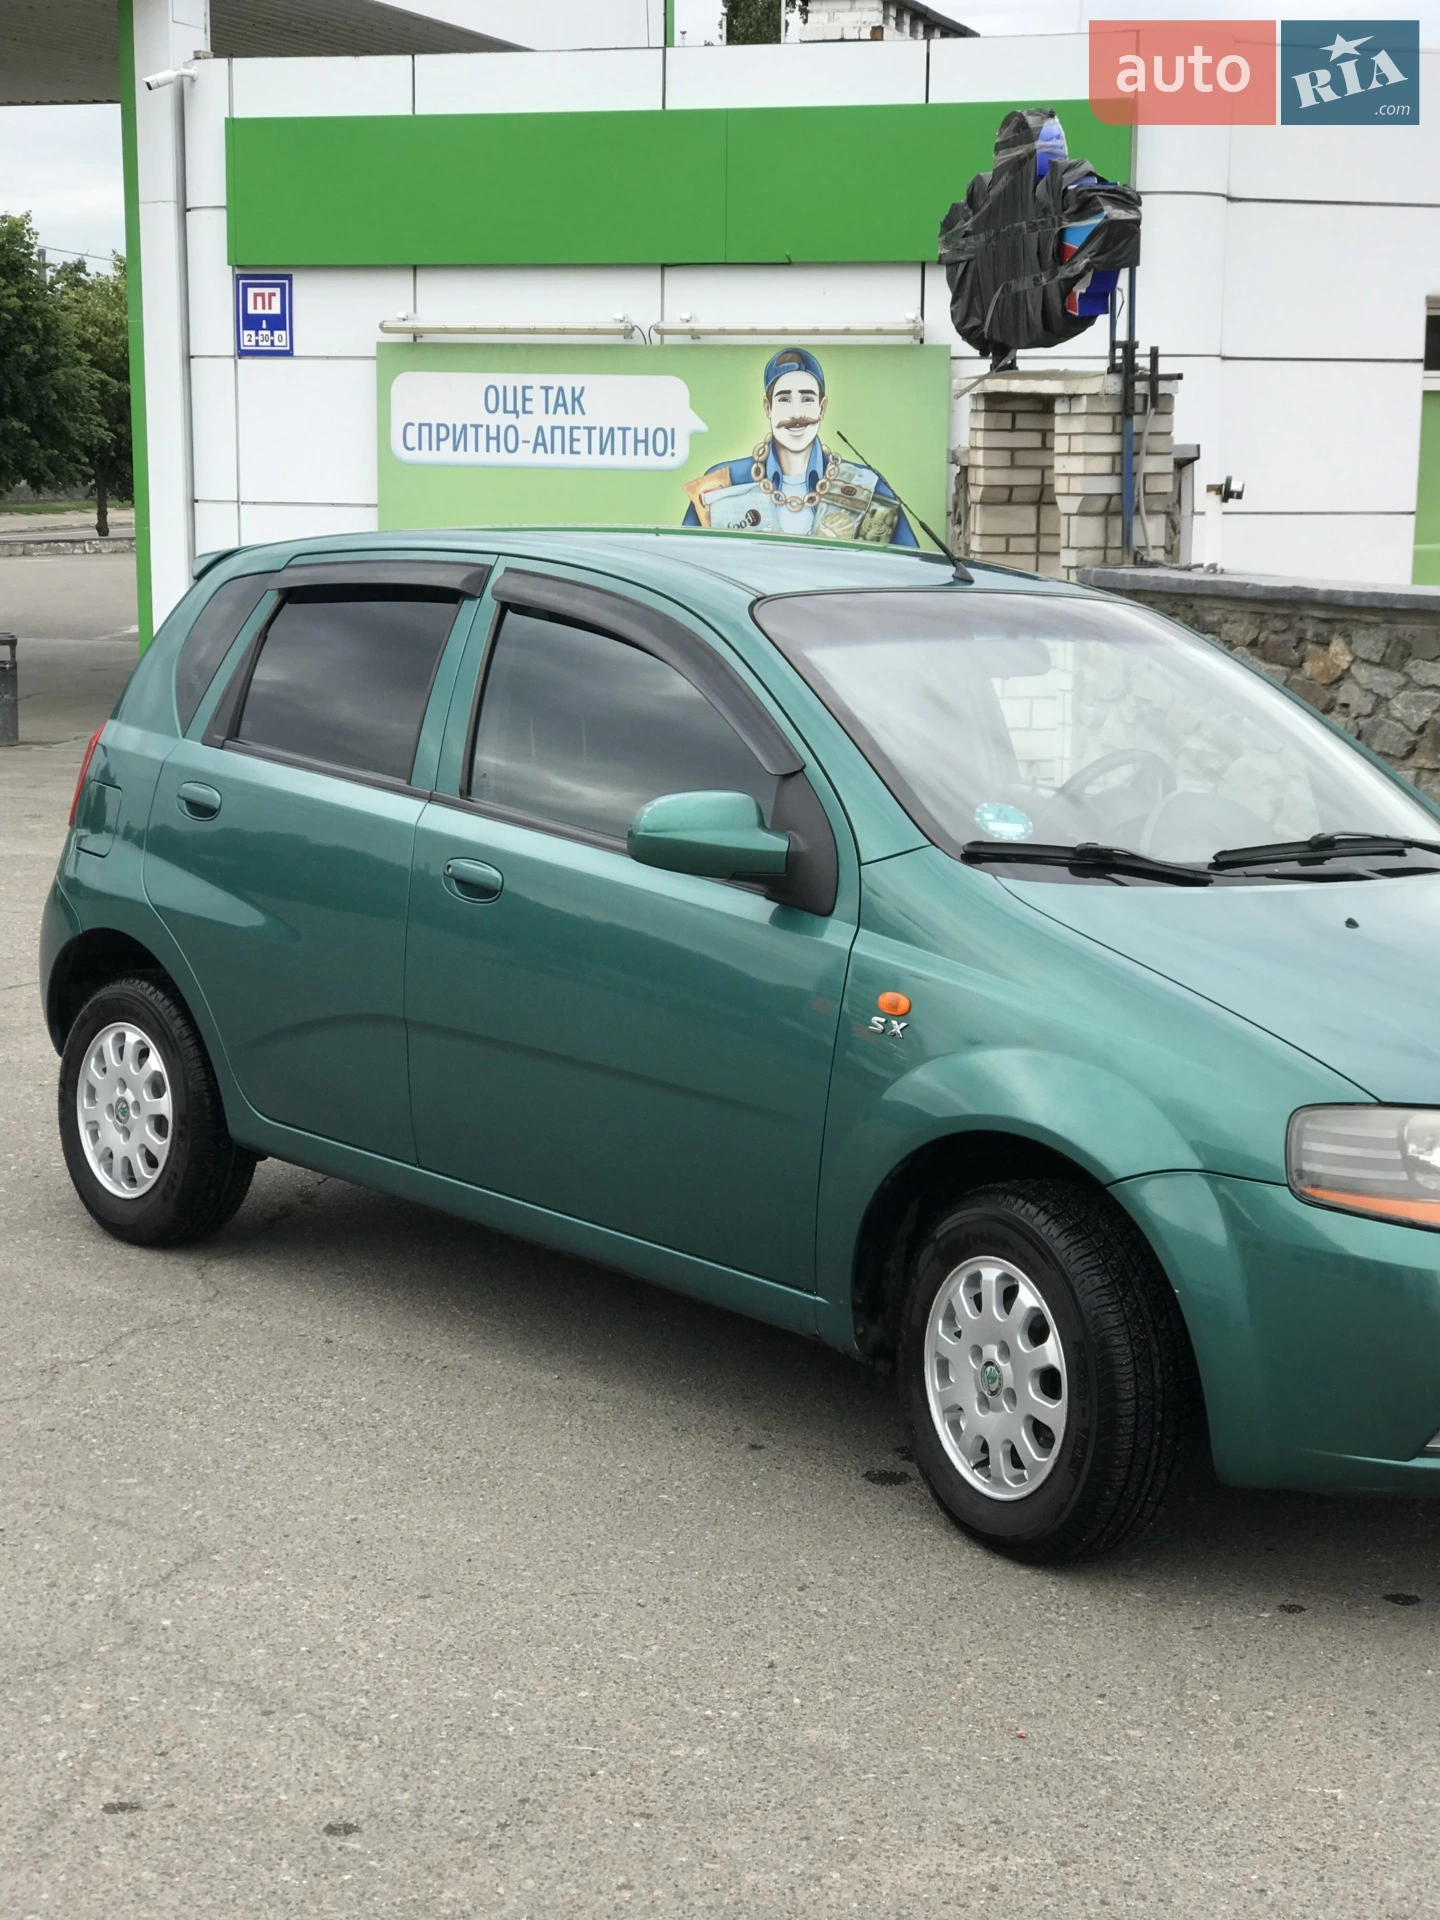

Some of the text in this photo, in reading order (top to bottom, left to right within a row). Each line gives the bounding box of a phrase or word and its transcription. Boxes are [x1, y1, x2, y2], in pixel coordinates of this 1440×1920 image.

[253, 292, 276, 310] ПГ
[484, 384, 586, 419] ОЦЕ ТАК
[402, 421, 676, 457] СПРИТНО-АПЕТИТНО!
[868, 1016, 908, 1038] SX
